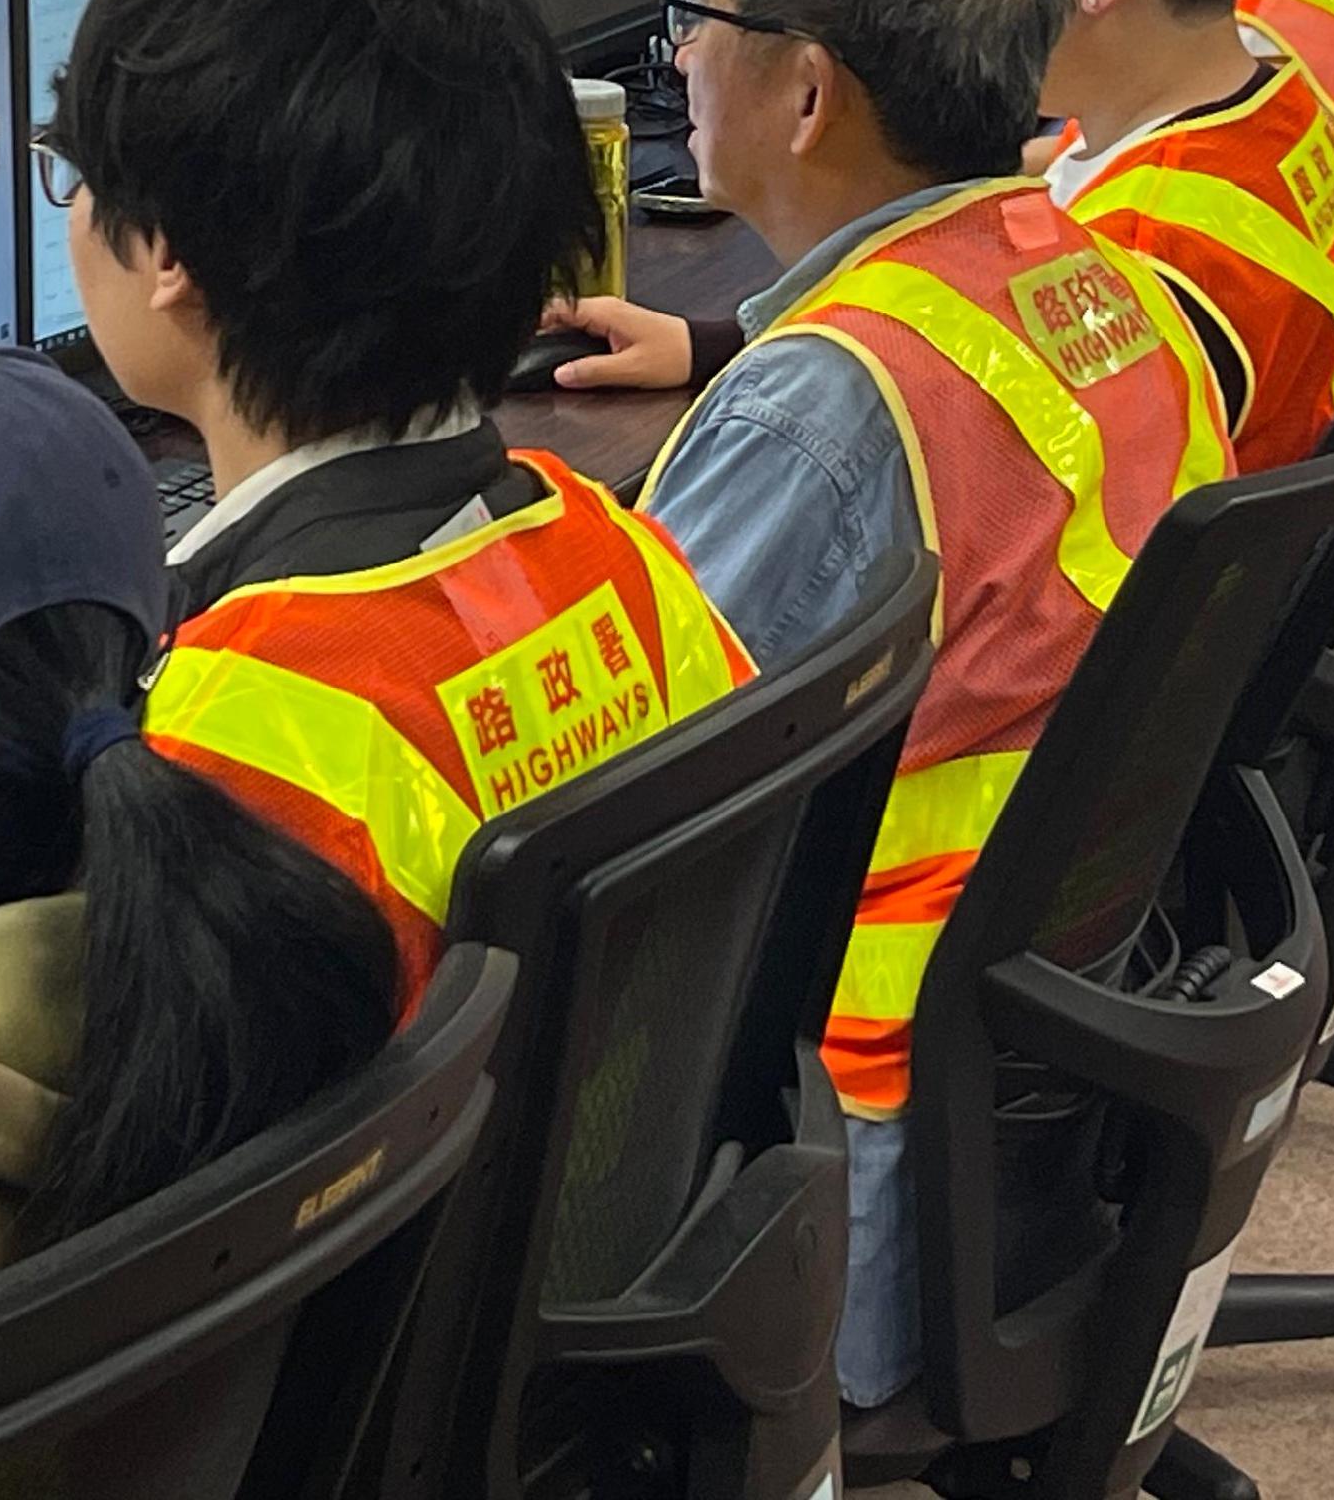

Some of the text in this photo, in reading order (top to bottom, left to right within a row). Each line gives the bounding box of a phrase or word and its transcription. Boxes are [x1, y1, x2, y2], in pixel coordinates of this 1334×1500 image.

[465, 611, 633, 757] 路政署
[489, 682, 651, 811] HIGHWAYS
